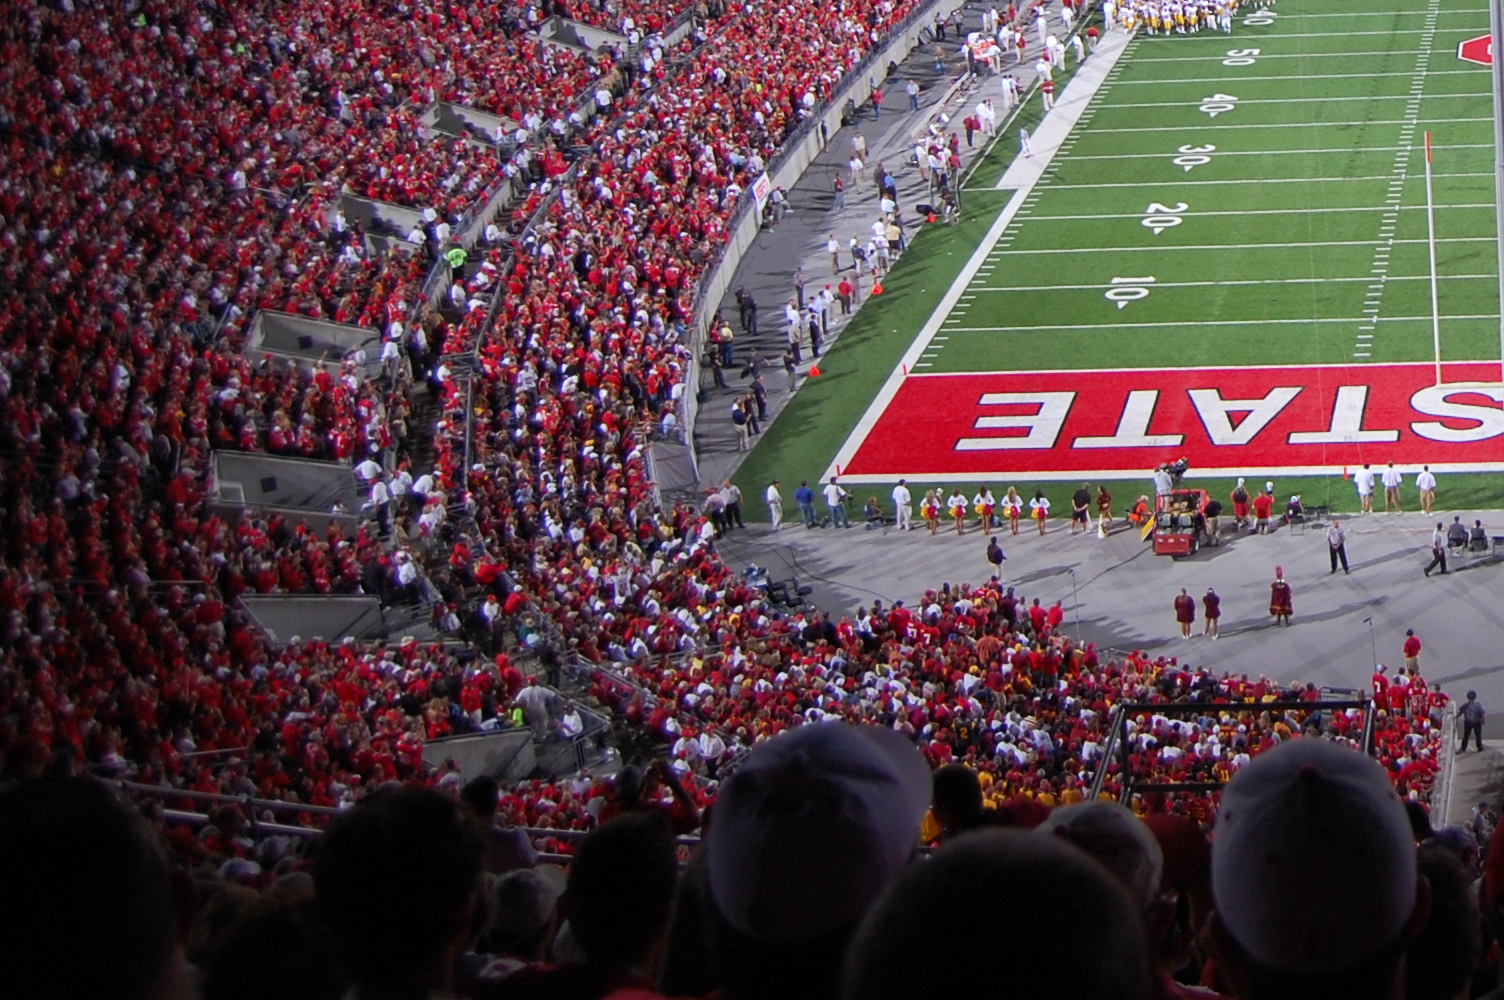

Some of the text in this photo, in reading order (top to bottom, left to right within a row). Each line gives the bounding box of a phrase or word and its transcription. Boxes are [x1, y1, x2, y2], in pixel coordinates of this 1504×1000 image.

[1243, 10, 1277, 25] 40
[1222, 48, 1260, 66] 50
[1199, 93, 1239, 112] 40
[1173, 144, 1216, 166] 30
[1141, 202, 1189, 227] 20
[1104, 275, 1156, 301] 10
[960, 726, 969, 739] 2
